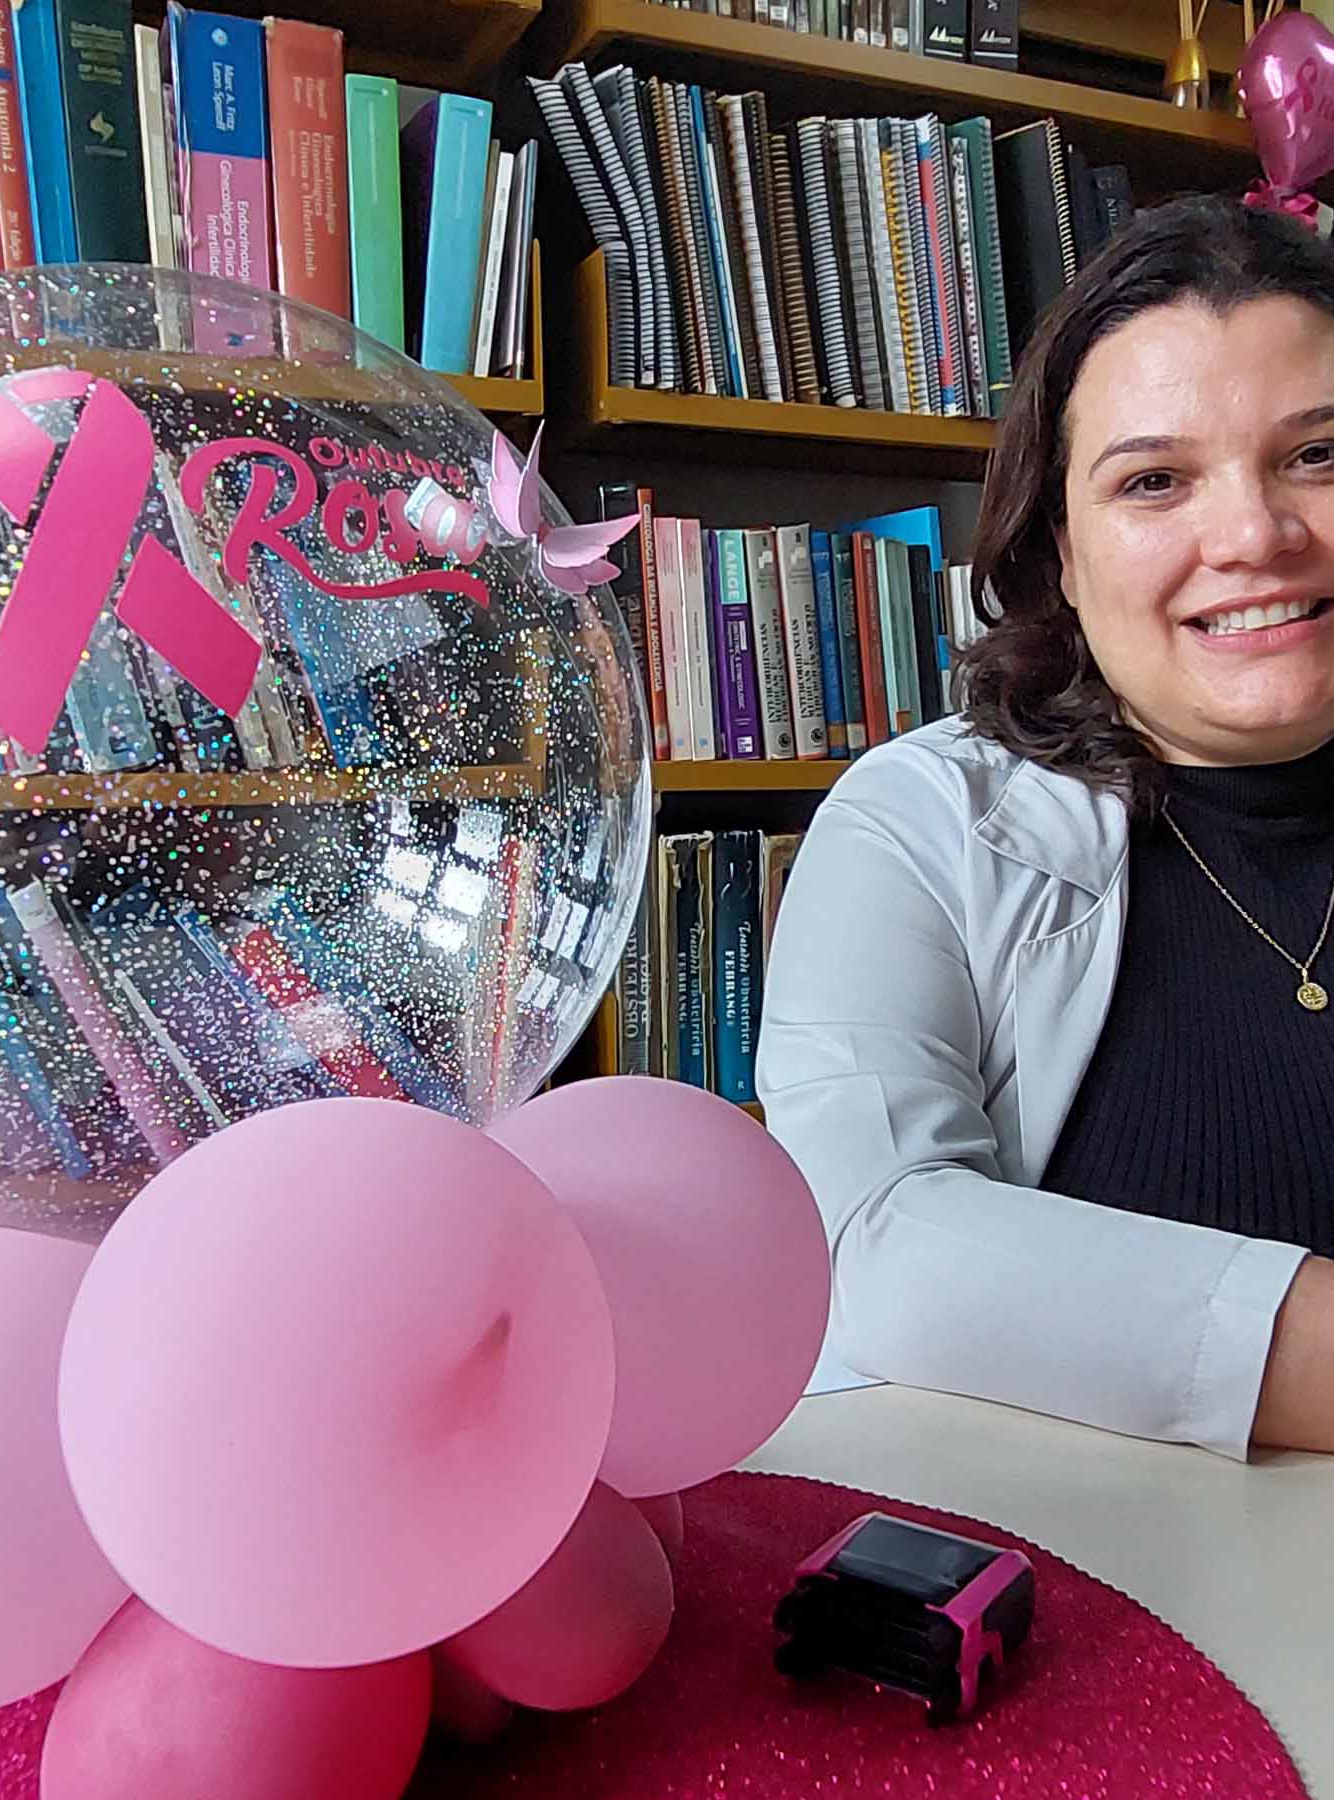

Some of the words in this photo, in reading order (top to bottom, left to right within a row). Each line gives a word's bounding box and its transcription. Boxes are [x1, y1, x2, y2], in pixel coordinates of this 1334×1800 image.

[213, 62, 223, 88] Leon
[225, 65, 234, 90] Marc
[3, 164, 16, 173] 2
[220, 160, 233, 236] Ginecológica
[303, 195, 317, 280] Infertilidade
[310, 437, 465, 486] Outubro
[179, 437, 489, 609] Rosa
[724, 540, 741, 600] LANGE
